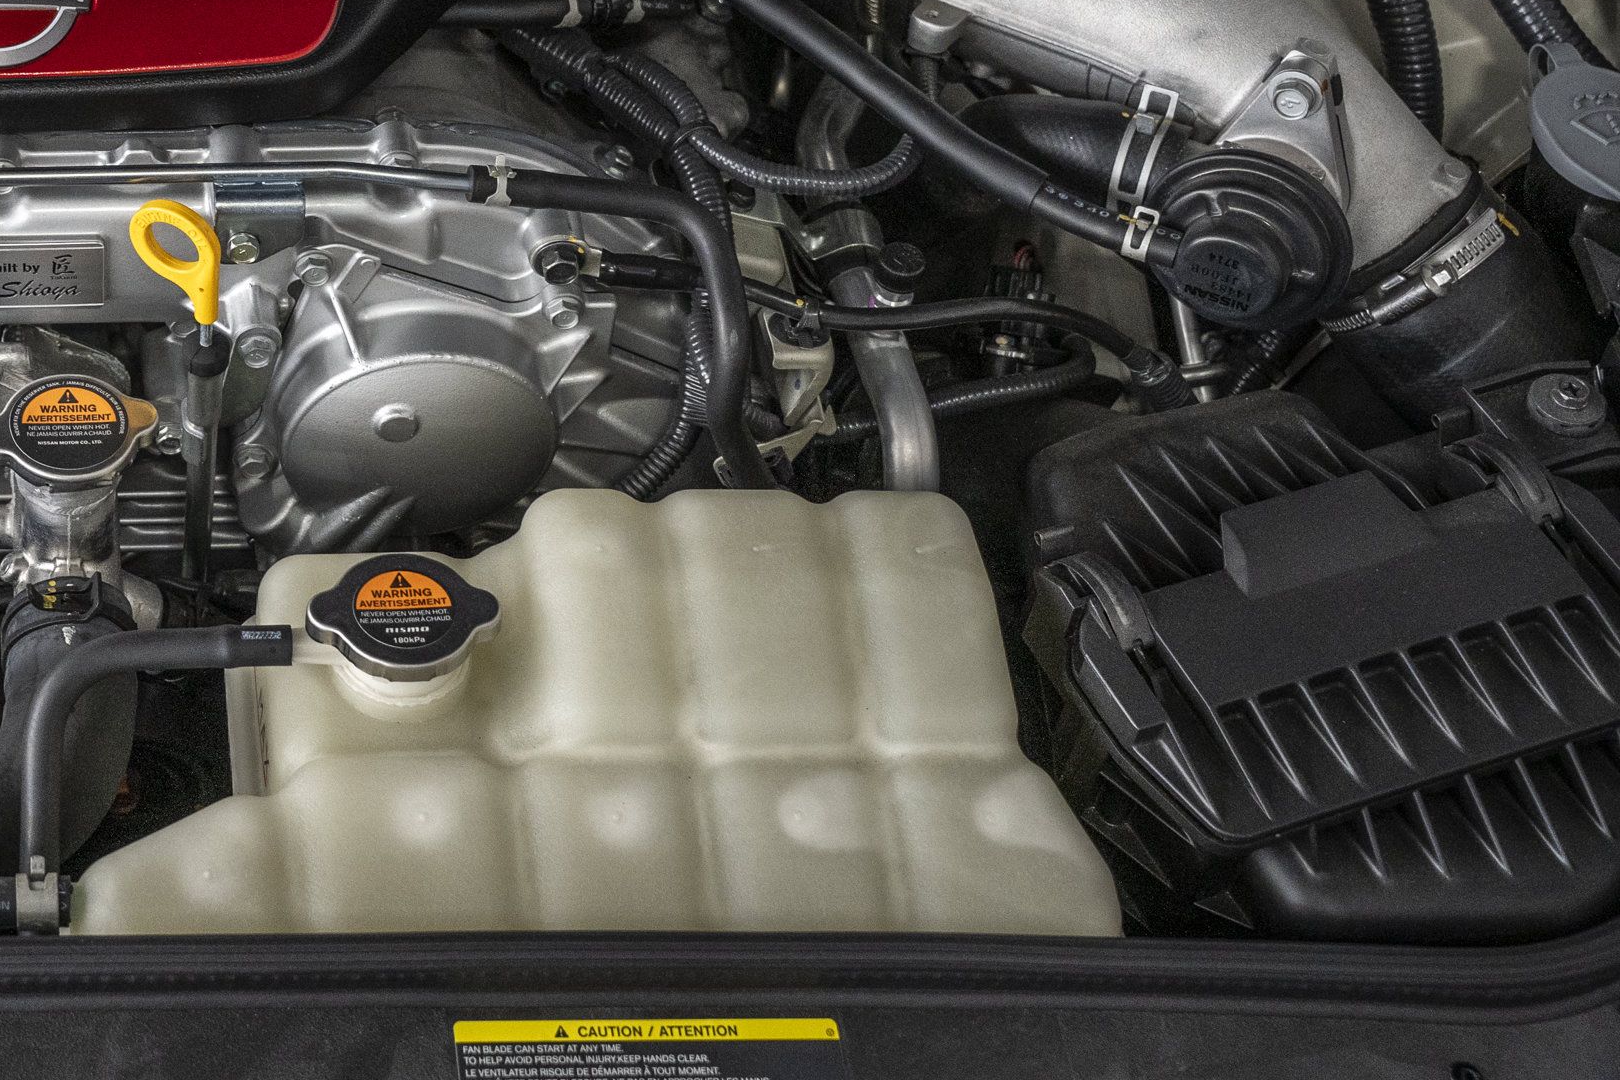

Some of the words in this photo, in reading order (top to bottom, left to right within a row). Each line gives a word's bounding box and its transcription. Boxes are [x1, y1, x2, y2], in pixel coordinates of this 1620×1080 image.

[22, 262, 40, 275] by
[52, 254, 75, 275] 匠
[1184, 284, 1249, 312] NISSAN
[40, 404, 96, 414] WARNING
[26, 413, 111, 422] AVERTISSEMENT
[371, 588, 432, 598] WARNING
[359, 597, 447, 607] AVERTISSEMENT
[578, 1025, 642, 1037] CAUTION
[648, 1026, 654, 1037] /
[659, 1025, 738, 1037] ATTENTION
[463, 1046, 480, 1054] FAN
[482, 1045, 512, 1053] BLADE
[514, 1045, 535, 1053] CAN
[537, 1044, 564, 1052] START
[567, 1044, 578, 1052] AT
[581, 1044, 598, 1052] ANY
[601, 1044, 623, 1052] TIME.
[464, 1056, 477, 1065] TO
[479, 1056, 502, 1064] HELP
[504, 1056, 533, 1064] AVOID
[534, 1055, 583, 1064] PERSONAL
[643, 1054, 675, 1063] HANDS
[465, 1069, 476, 1077] LE
[478, 1068, 538, 1077] VENTILATEUR
[539, 1067, 574, 1077] RISQUE
[577, 1067, 590, 1076] DE
[644, 1065, 650, 1075] À
[652, 1067, 676, 1075] TOUT
[679, 1066, 721, 1075] MOMENT.
